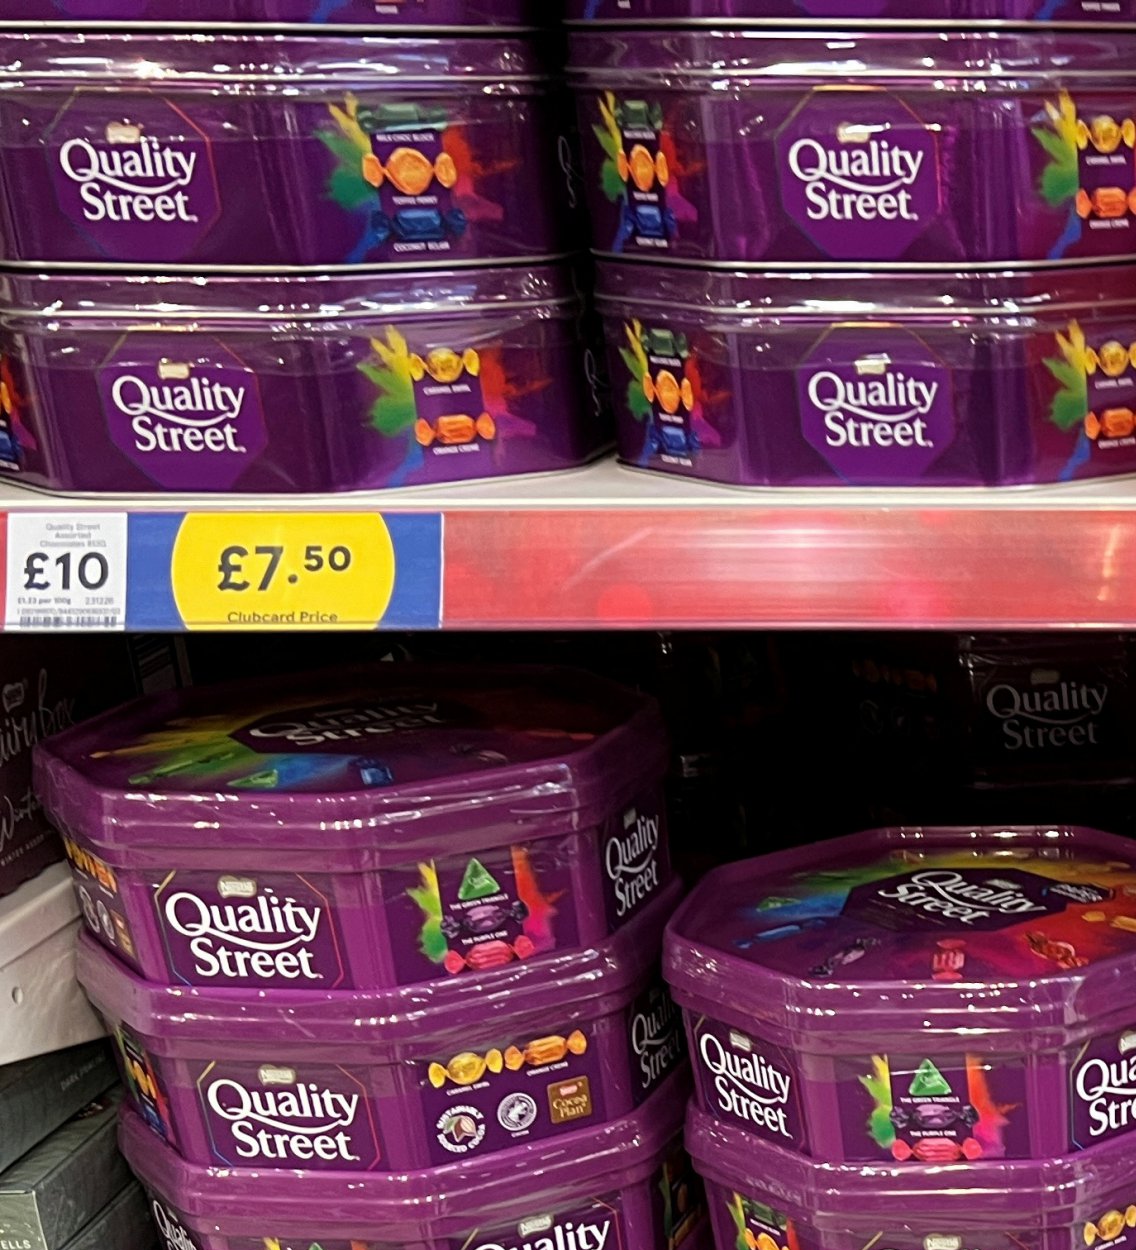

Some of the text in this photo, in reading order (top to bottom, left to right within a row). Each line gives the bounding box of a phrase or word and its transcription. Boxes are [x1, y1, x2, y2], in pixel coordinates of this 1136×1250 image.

[60, 138, 197, 194] Quality
[788, 138, 923, 194] Quality
[111, 375, 245, 427] Quality
[807, 370, 937, 423] Quality
[24, 551, 109, 591] £10
[217, 545, 352, 592] £7.50
[226, 610, 338, 624] Clubcard Price
[986, 680, 1108, 725] Quality
[606, 814, 660, 874] Quality
[910, 869, 1048, 916] Quality
[165, 891, 320, 951] Quality
[190, 937, 323, 979] Street
[700, 1033, 791, 1105] Quality
[207, 1078, 358, 1134] Quality
[716, 1075, 794, 1139] Street
[230, 1121, 360, 1161] Street
[0, 1238, 32, 1250] ELLS
